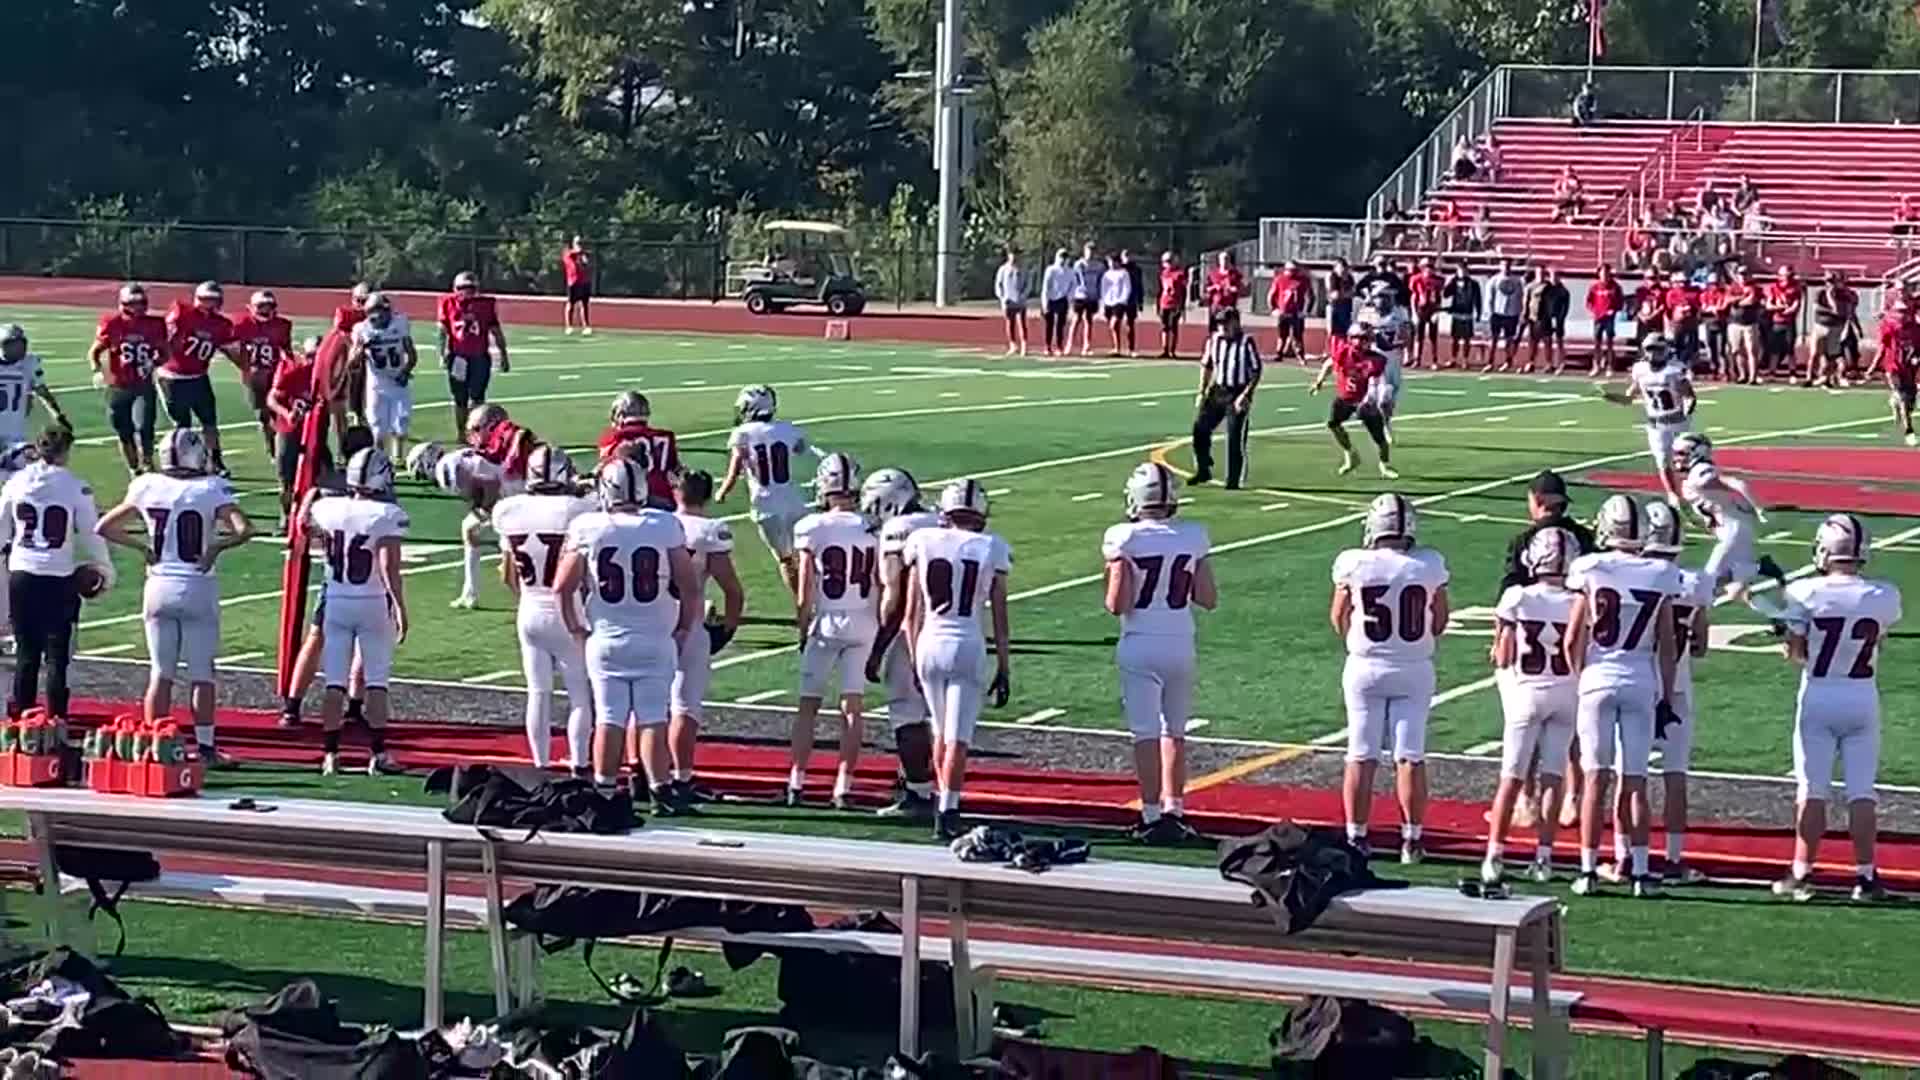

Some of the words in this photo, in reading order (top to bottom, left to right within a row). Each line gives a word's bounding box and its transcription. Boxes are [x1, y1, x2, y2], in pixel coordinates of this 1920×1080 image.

[120, 342, 150, 363] 66
[184, 336, 212, 360] 70
[754, 441, 790, 487] 10
[147, 507, 204, 562] 70
[507, 534, 566, 587] 57
[597, 546, 660, 603] 68
[1132, 554, 1194, 610] 76
[1361, 584, 1427, 642] 50
[1519, 619, 1570, 677] 33
[1812, 617, 1881, 679] 72
[48, 759, 60, 778] G
[180, 768, 192, 787] G
